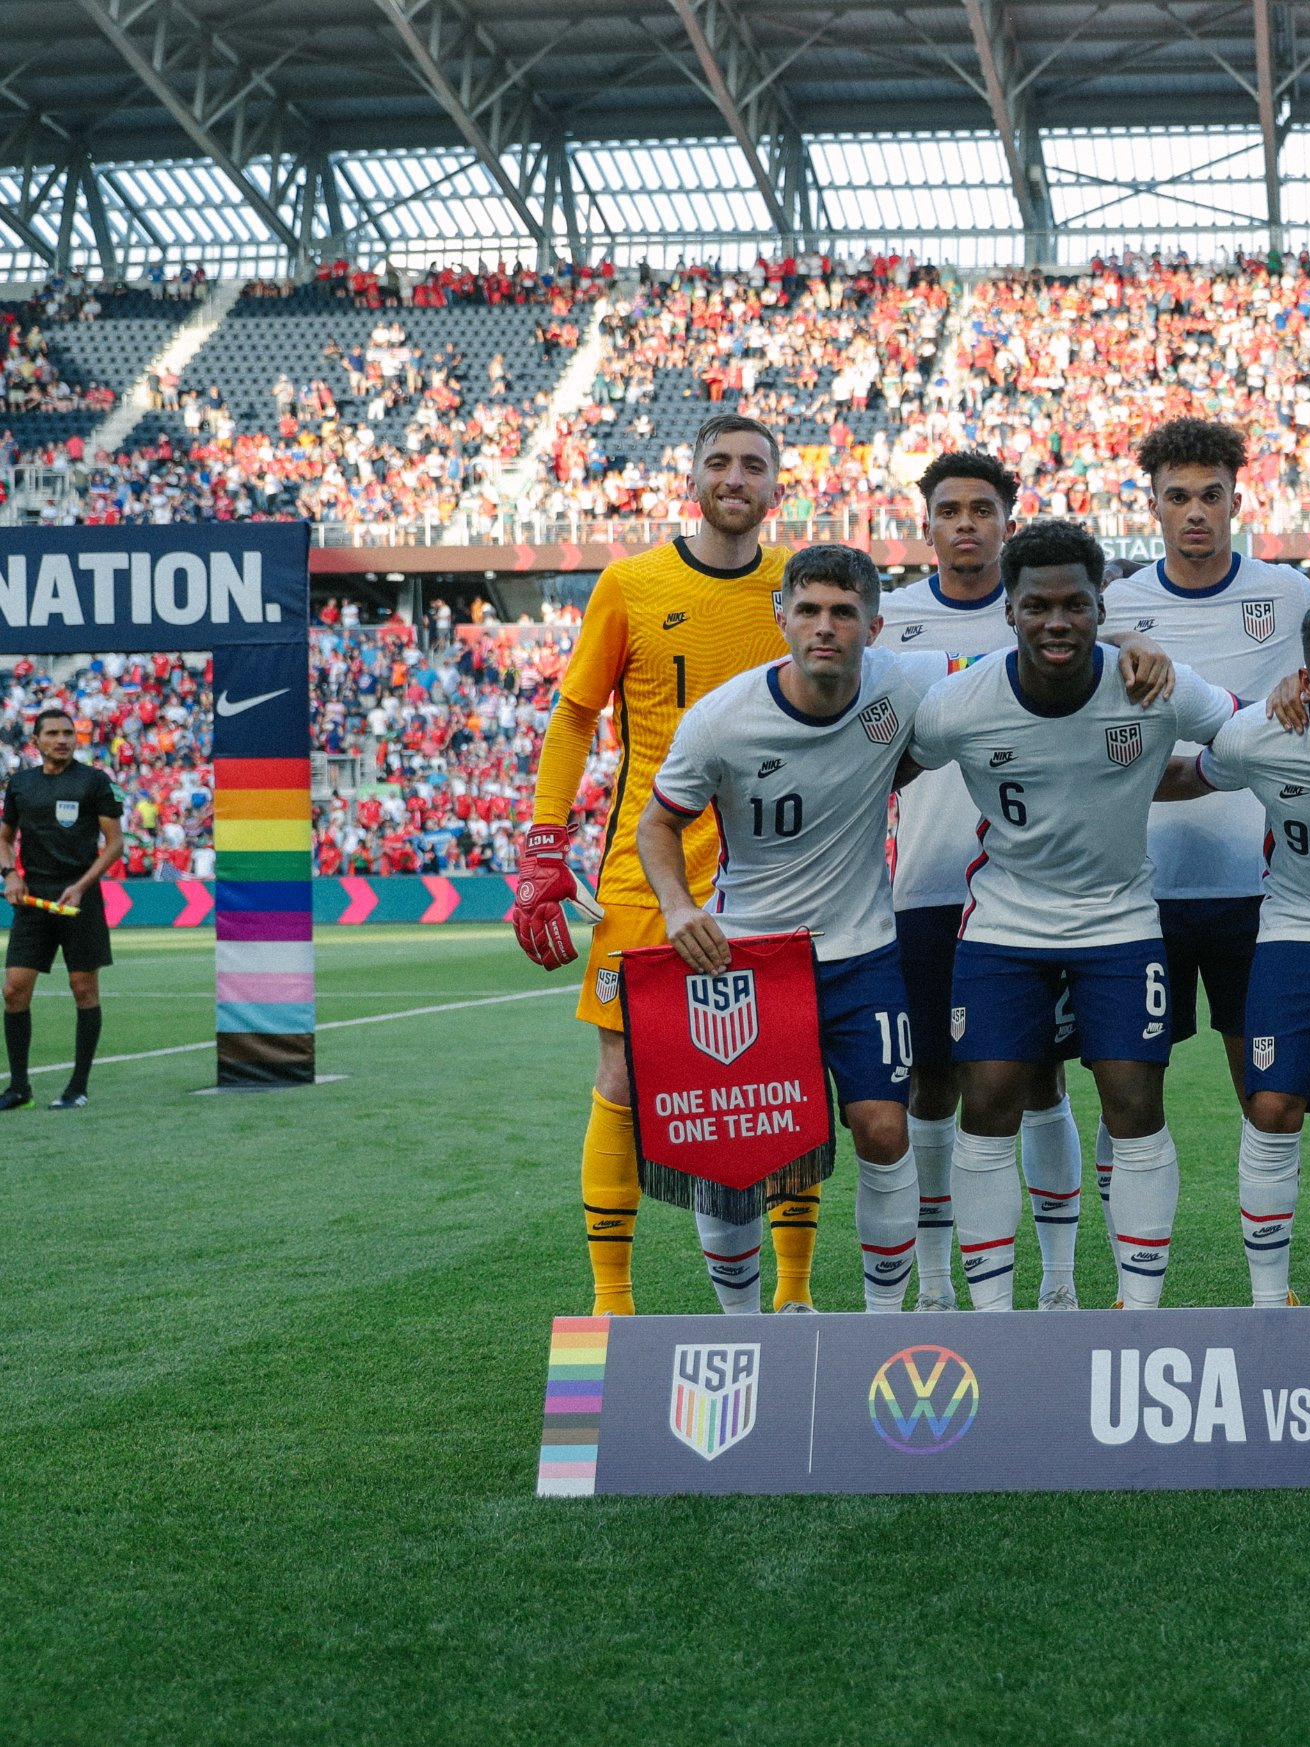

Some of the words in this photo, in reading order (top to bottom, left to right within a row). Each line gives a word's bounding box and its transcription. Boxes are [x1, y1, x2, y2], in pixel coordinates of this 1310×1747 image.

[667, 611, 686, 622] NIKE
[1246, 603, 1271, 619] USA
[905, 624, 924, 635] NIKE
[1137, 619, 1155, 629] NIKE
[673, 655, 685, 708] 1
[861, 701, 889, 723] USA
[1109, 727, 1137, 744] USA
[993, 751, 1014, 761] NIKE
[761, 758, 782, 771] NIKE
[1284, 785, 1304, 795] NIKE
[999, 781, 1026, 827] 6
[751, 793, 802, 837] 10
[1284, 820, 1309, 855] 9
[600, 971, 617, 984] USA
[691, 975, 750, 1011] USA
[1146, 963, 1166, 1016] 6
[1147, 1022, 1163, 1033] NIKE
[875, 1012, 913, 1067] 10
[1254, 1038, 1273, 1052] USA
[656, 1090, 704, 1116] ONE
[711, 1080, 808, 1111] NATION.
[668, 1118, 718, 1144] ONE
[724, 1110, 800, 1139] TEAM.
[880, 1259, 903, 1269] NIKE
[965, 1256, 983, 1266] NIKE
[1137, 1252, 1159, 1260] NIKE
[679, 1350, 755, 1392] USA
[1091, 1347, 1247, 1444] USA
